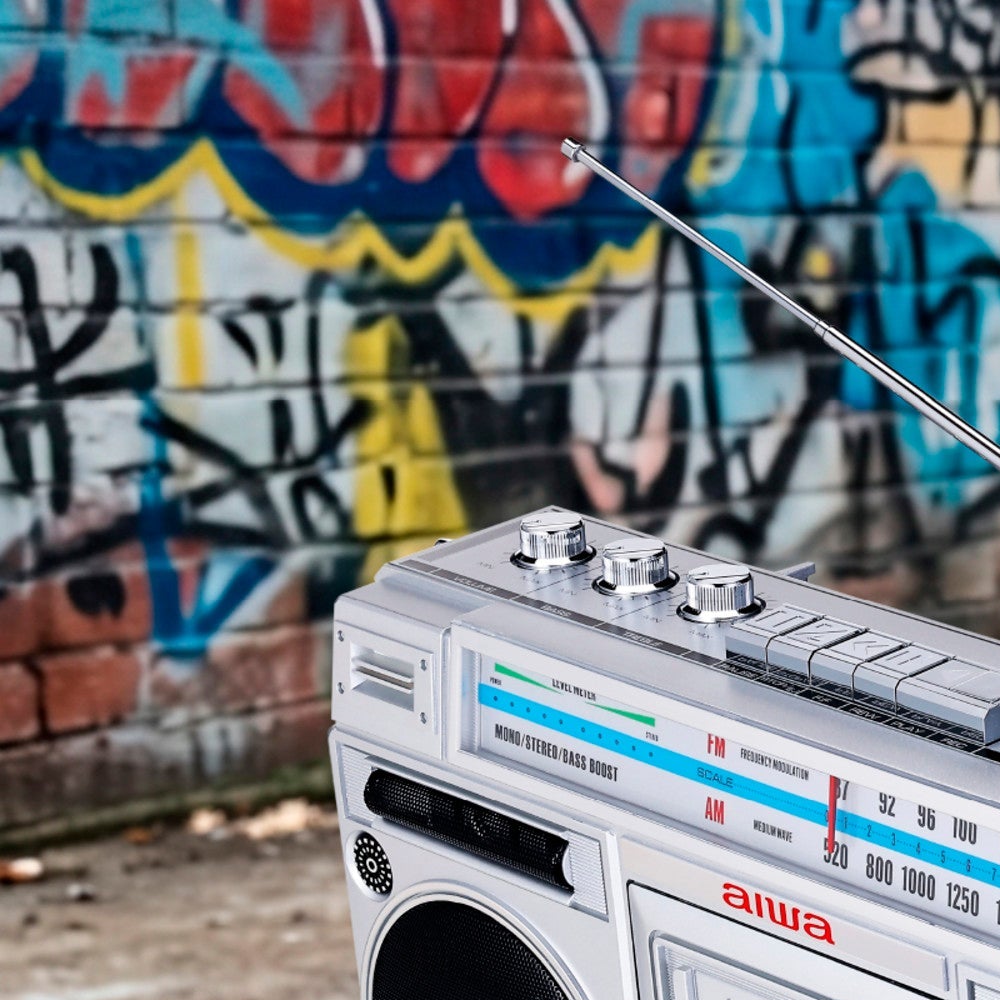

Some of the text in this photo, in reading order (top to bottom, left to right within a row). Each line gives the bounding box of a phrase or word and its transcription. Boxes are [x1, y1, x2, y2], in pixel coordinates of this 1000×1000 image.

[552, 678, 597, 701] LEVEL METER
[891, 721, 926, 735] PLAY
[494, 723, 619, 782] MONO/STEREO/BASS BOOST
[707, 733, 726, 759] FM
[696, 766, 734, 789] SCALE
[740, 747, 810, 781] FREQUENCY MODULATION
[705, 796, 725, 825] AM
[879, 791, 896, 817] 92
[917, 804, 936, 831] 96
[952, 815, 978, 845] 100
[866, 824, 872, 838] 2
[823, 837, 848, 870] 520
[866, 853, 893, 886] 800
[901, 866, 936, 902] 1000
[946, 882, 980, 917] 1250
[722, 882, 835, 945] aiwa
